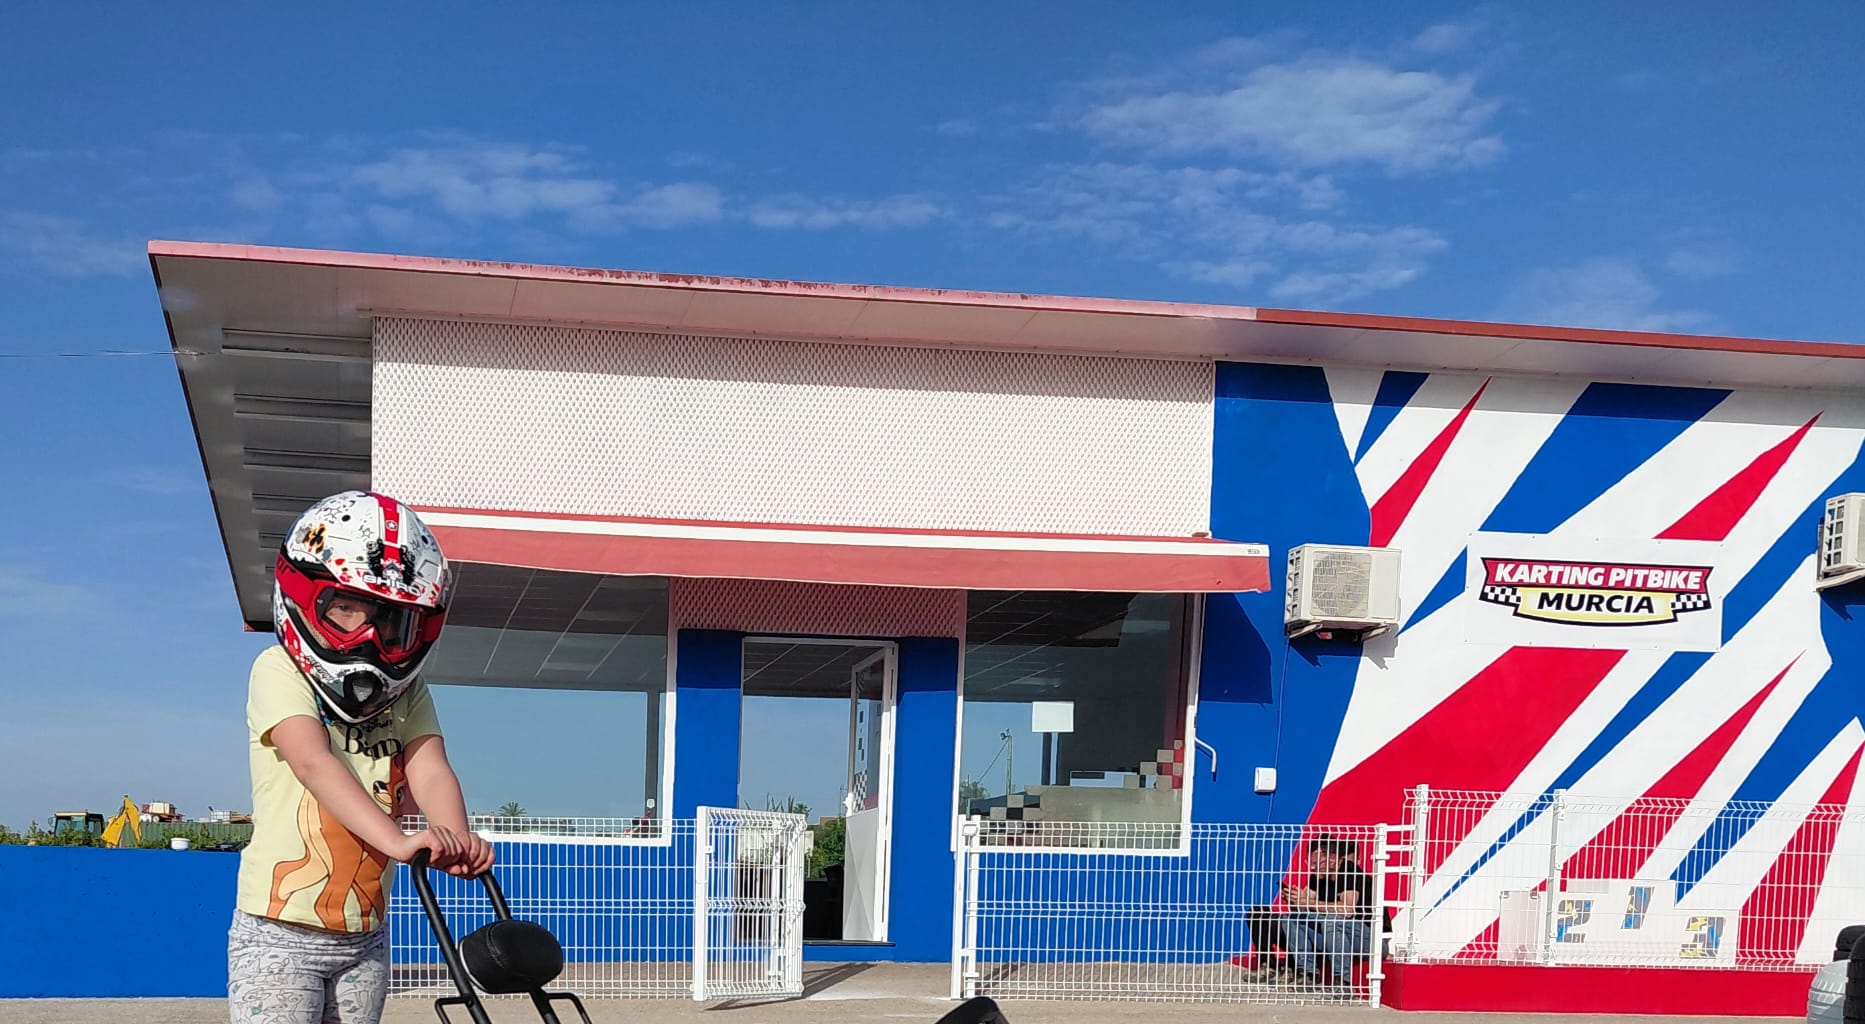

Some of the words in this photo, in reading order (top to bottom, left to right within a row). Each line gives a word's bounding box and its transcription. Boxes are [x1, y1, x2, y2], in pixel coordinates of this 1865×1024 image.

[363, 574, 422, 597] SHIRO
[1494, 562, 1605, 587] KARTING
[1608, 566, 1703, 591] PITBIKE
[1536, 591, 1656, 614] MURCIA
